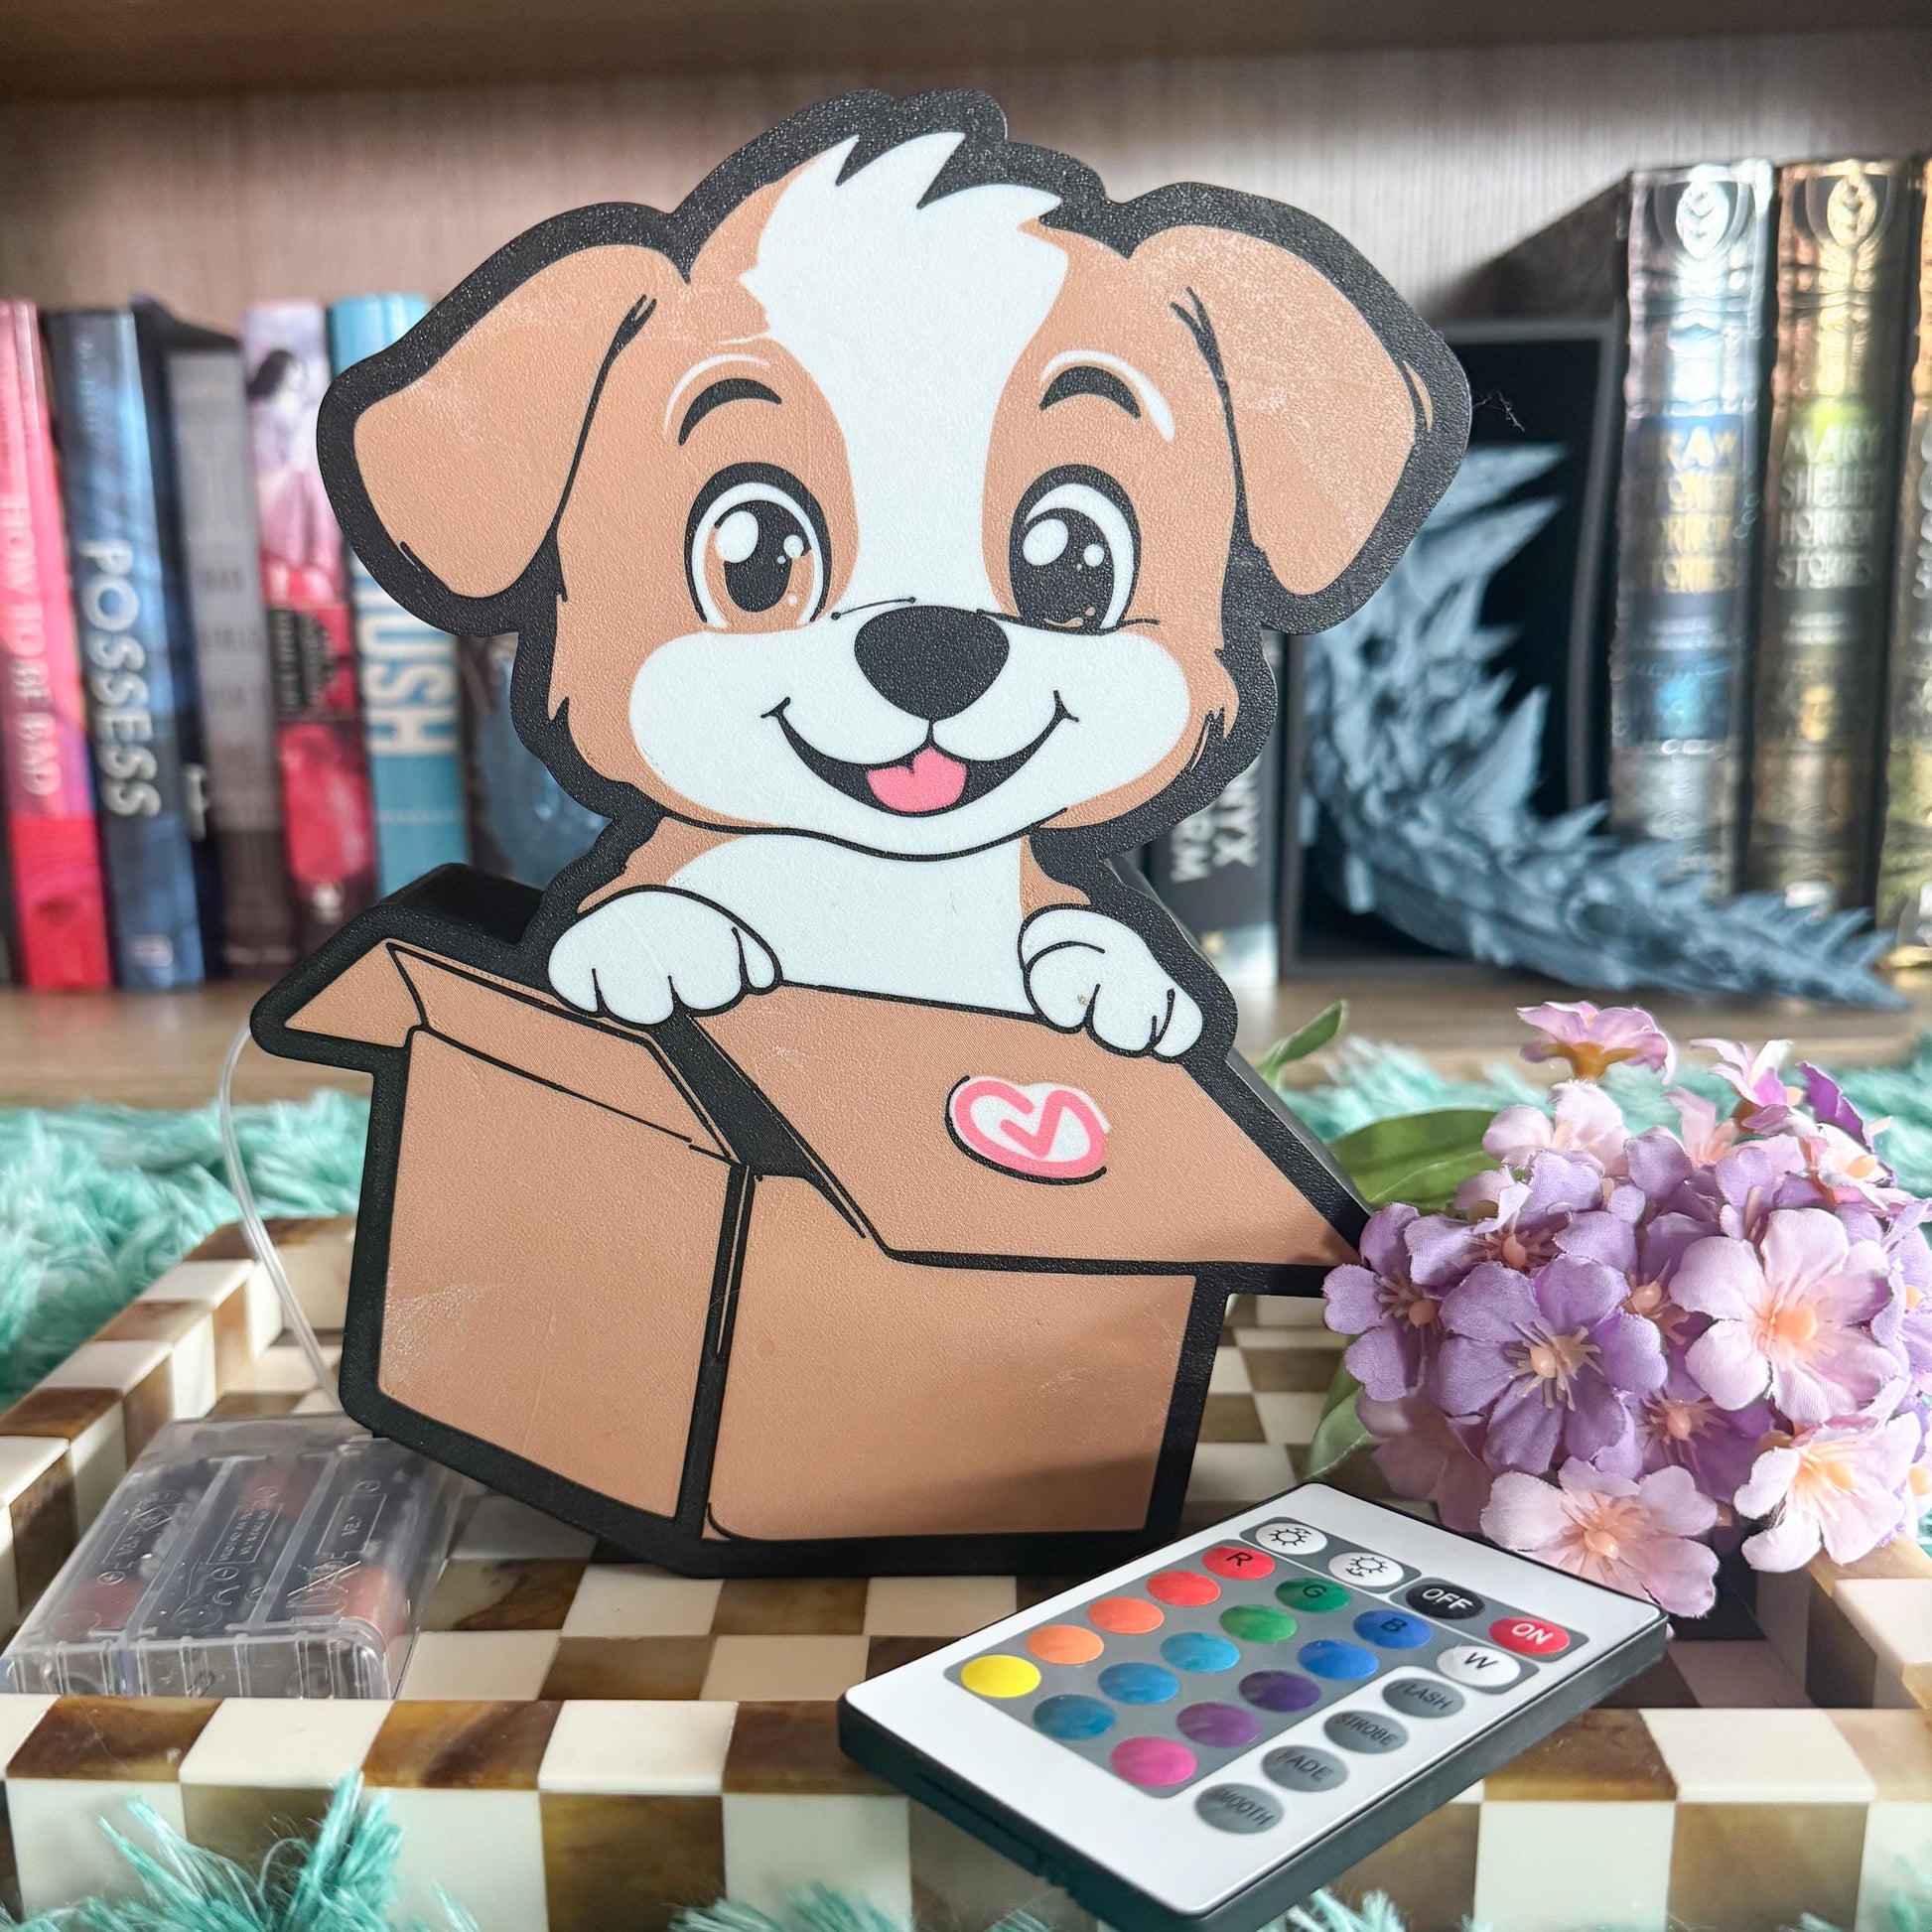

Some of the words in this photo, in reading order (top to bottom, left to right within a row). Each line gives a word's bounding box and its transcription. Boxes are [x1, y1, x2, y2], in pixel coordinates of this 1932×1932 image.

[2, 494, 37, 596] HOW
[8, 603, 45, 657] TO
[350, 551, 459, 757] USH
[77, 537, 161, 817] POSSESS
[1226, 1552, 1252, 1567] R
[1303, 1585, 1327, 1598] G
[1422, 1587, 1473, 1610] OFF
[1380, 1617, 1407, 1632] B
[1511, 1622, 1554, 1644] ON
[1464, 1652, 1498, 1669] W
[1212, 1786, 1274, 1826] MOOTH
